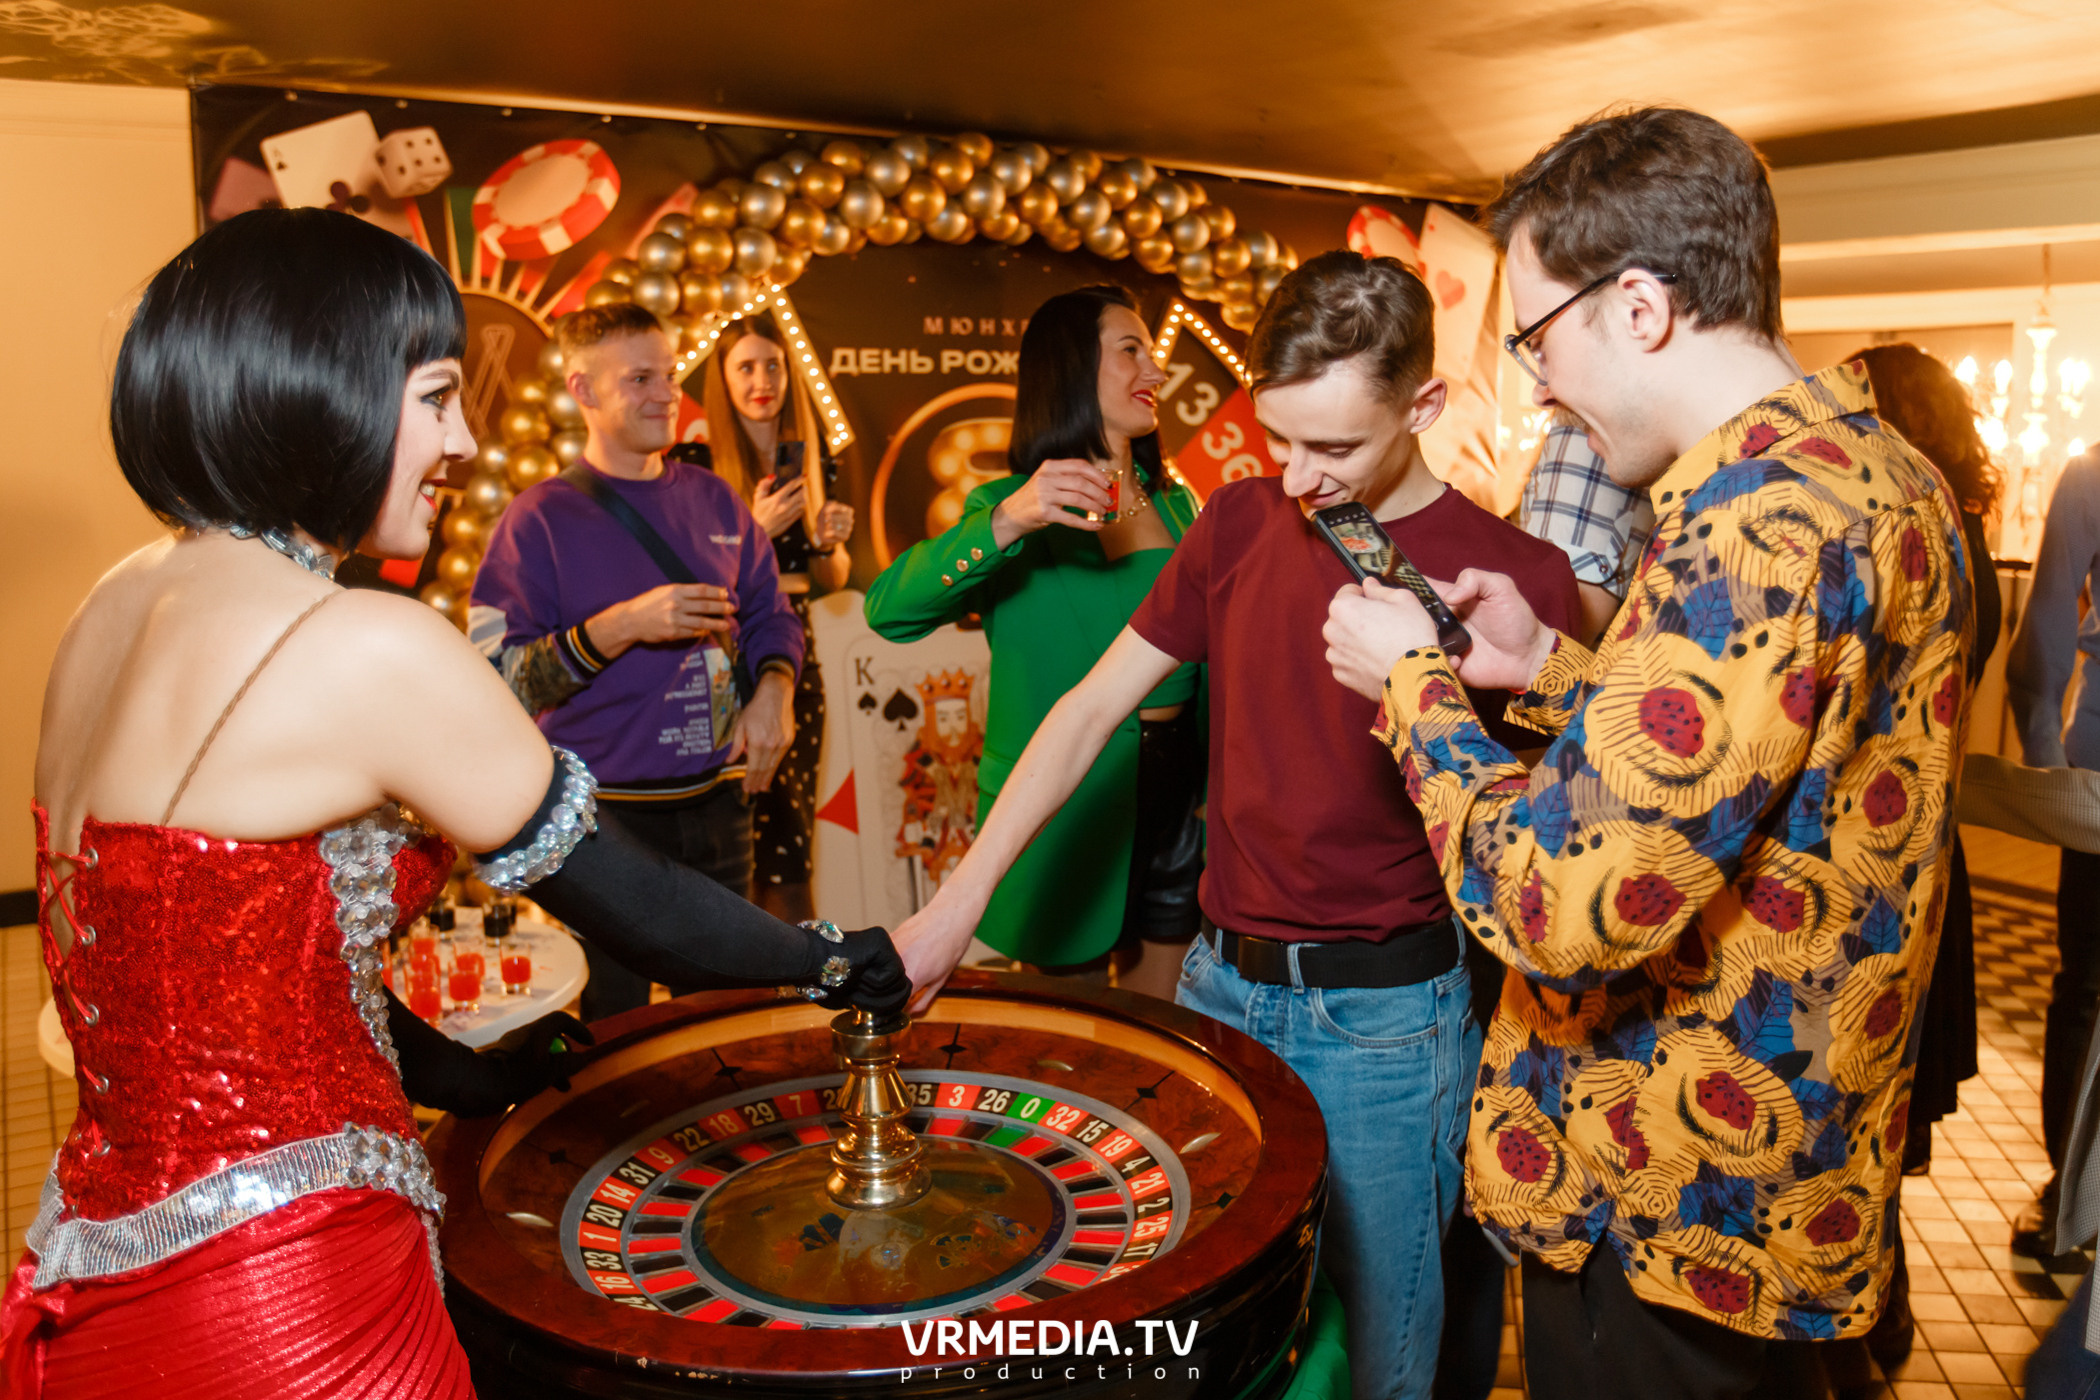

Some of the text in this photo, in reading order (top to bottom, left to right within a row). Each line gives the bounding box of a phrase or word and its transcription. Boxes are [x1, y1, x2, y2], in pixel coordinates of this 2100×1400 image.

[829, 347, 935, 377] ДЕНЬ
[1158, 363, 1219, 426] 13
[1201, 421, 1263, 484] 36
[855, 656, 875, 686] K
[788, 1094, 801, 1115] 7
[948, 1085, 966, 1107] 3
[978, 1089, 1010, 1113] 26
[744, 1102, 776, 1126] 29
[1020, 1097, 1041, 1119] 0
[1046, 1105, 1081, 1131] 32
[708, 1114, 740, 1136] 18
[1076, 1119, 1109, 1143] 15
[674, 1127, 710, 1151] 22
[1100, 1134, 1133, 1158] 19
[648, 1147, 675, 1165] 9
[1121, 1155, 1151, 1173] 4
[619, 1159, 656, 1184] 31
[1131, 1171, 1163, 1194] 21
[600, 1182, 636, 1204] 14
[586, 1203, 624, 1228] 20
[1137, 1197, 1171, 1213] 2
[583, 1230, 617, 1242] 1
[1133, 1216, 1170, 1238] 25
[1123, 1242, 1159, 1257] 17
[584, 1251, 621, 1271] 33
[595, 1276, 634, 1289] 16
